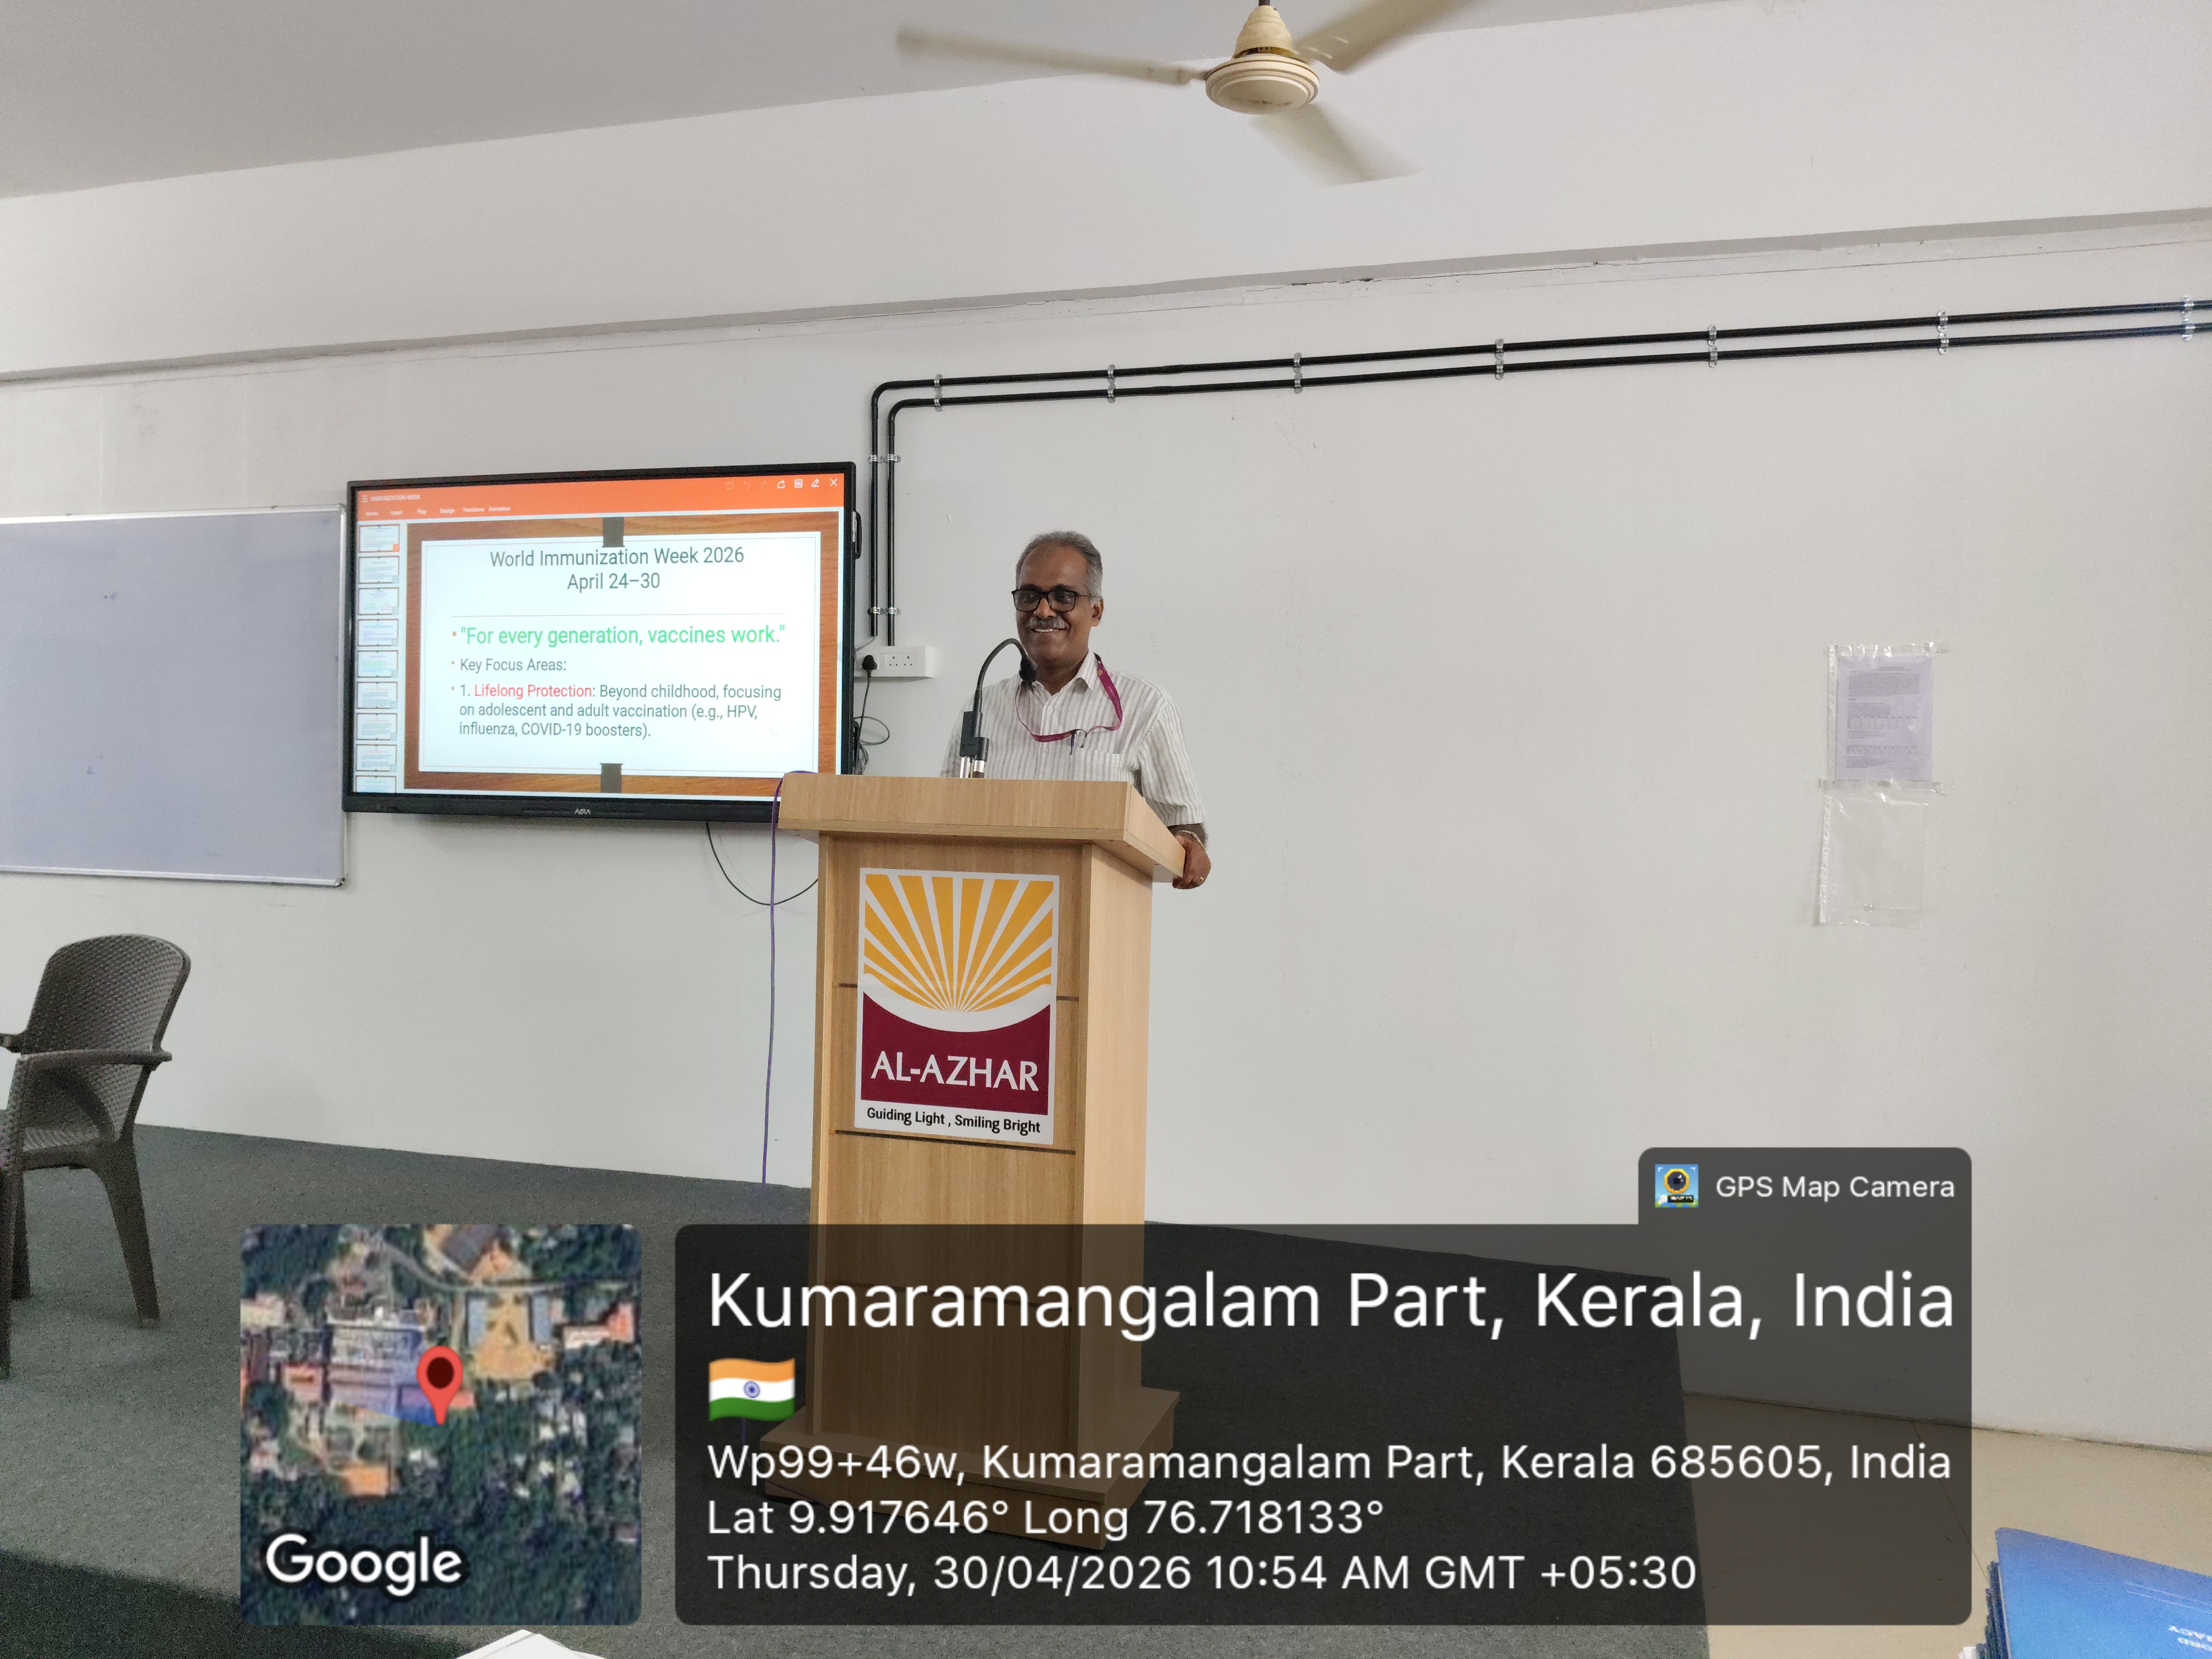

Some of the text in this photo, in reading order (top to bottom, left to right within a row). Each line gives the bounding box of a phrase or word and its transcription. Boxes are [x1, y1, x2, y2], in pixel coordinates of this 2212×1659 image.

[490, 546, 744, 567] World Immunization Week 2026
[567, 572, 603, 594] April
[461, 624, 785, 648] "For every generation, vaccines work."
[461, 658, 567, 674] Key Focus Areas:
[460, 684, 781, 702] 1. Lifelong Protection: Beyond childhood, focusing
[460, 703, 757, 721] on adolescent and adult vaccination (e.g., HPV,
[460, 721, 651, 739] influenza, COVID-19 boosters).
[871, 1050, 1039, 1091] AL-AZHAR
[867, 1107, 912, 1126] Guiding
[915, 1111, 945, 1127] Light
[954, 1114, 1001, 1134] Smiling
[1003, 1118, 1041, 1136] Bright
